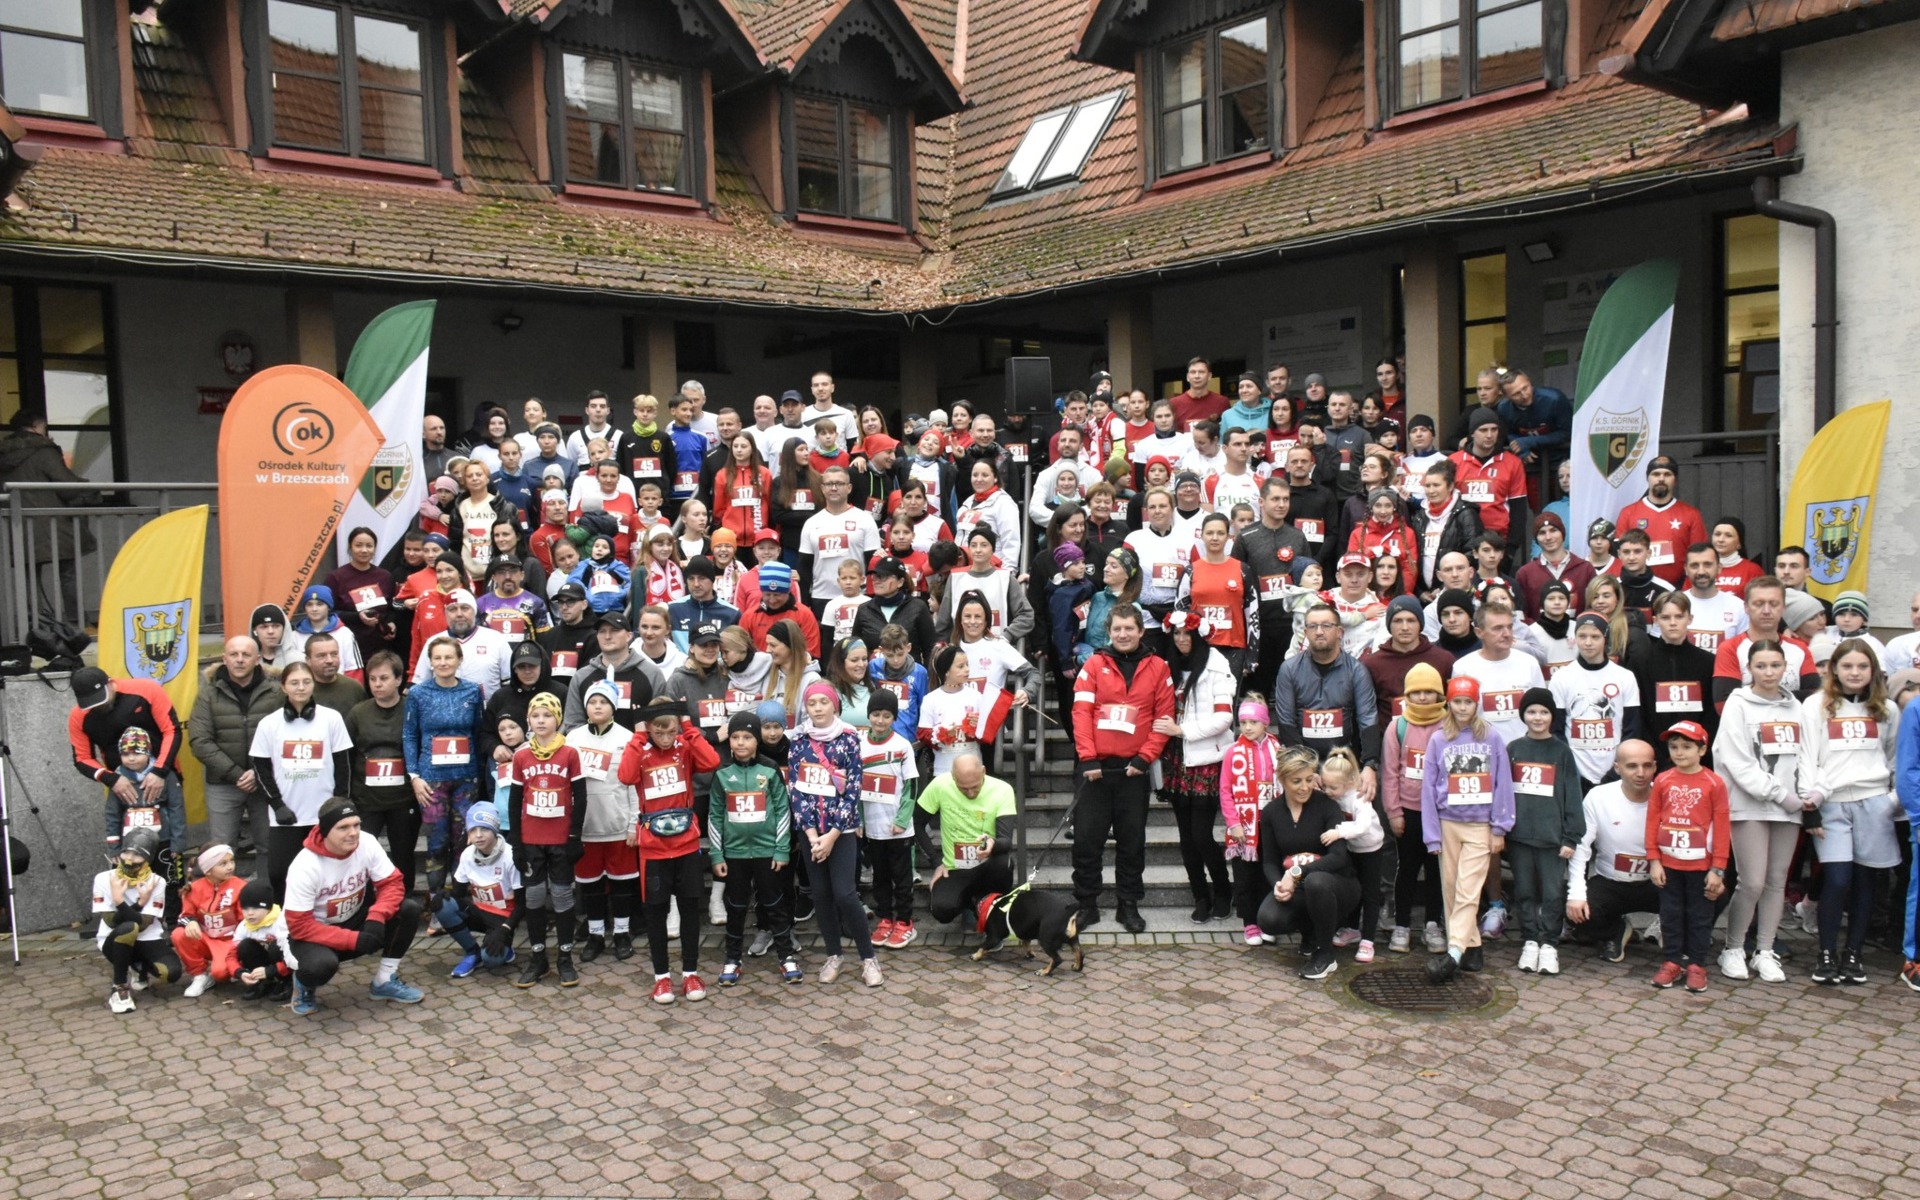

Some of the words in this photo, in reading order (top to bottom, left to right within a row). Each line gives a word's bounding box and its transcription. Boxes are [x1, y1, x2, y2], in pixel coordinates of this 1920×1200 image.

[296, 423, 323, 442] ok
[1610, 438, 1626, 458] G
[258, 460, 304, 471] Ośrodek
[307, 460, 346, 473] Kultury
[642, 460, 654, 471] 45
[256, 475, 270, 484] w
[272, 472, 350, 485] Brzeszczach
[376, 470, 392, 490] G
[681, 474, 692, 484] 16
[1467, 482, 1488, 494] 120
[1217, 494, 1250, 507] Plus
[1302, 522, 1316, 534] 80
[824, 538, 842, 550] 172
[1161, 566, 1177, 580] 95
[1266, 577, 1285, 592] 127
[1203, 606, 1226, 620] 128
[502, 620, 511, 634] 9
[1693, 632, 1718, 648] 181
[557, 654, 564, 668] 8
[1669, 686, 1688, 701] 81
[707, 702, 726, 717] 140
[1496, 694, 1513, 710] 31
[1309, 714, 1335, 728] 122
[1577, 722, 1606, 739] 166
[1774, 725, 1795, 743] 50
[1840, 720, 1866, 739] 89
[292, 744, 312, 760] 46
[447, 740, 458, 754] 4
[377, 762, 393, 776] 77
[522, 764, 568, 781] POLSKA
[649, 764, 678, 787] 139
[804, 765, 830, 782] 138
[1521, 766, 1541, 784] 28
[874, 778, 880, 793] 1
[1458, 778, 1482, 794] 99
[532, 790, 558, 808] 160
[735, 796, 756, 812] 54
[127, 810, 154, 827] 185
[1668, 816, 1691, 826] POLSKA
[1669, 830, 1690, 849] 73
[1628, 858, 1648, 874] 72
[474, 886, 494, 902] 161
[334, 896, 360, 917] 165
[203, 913, 224, 930] 85
